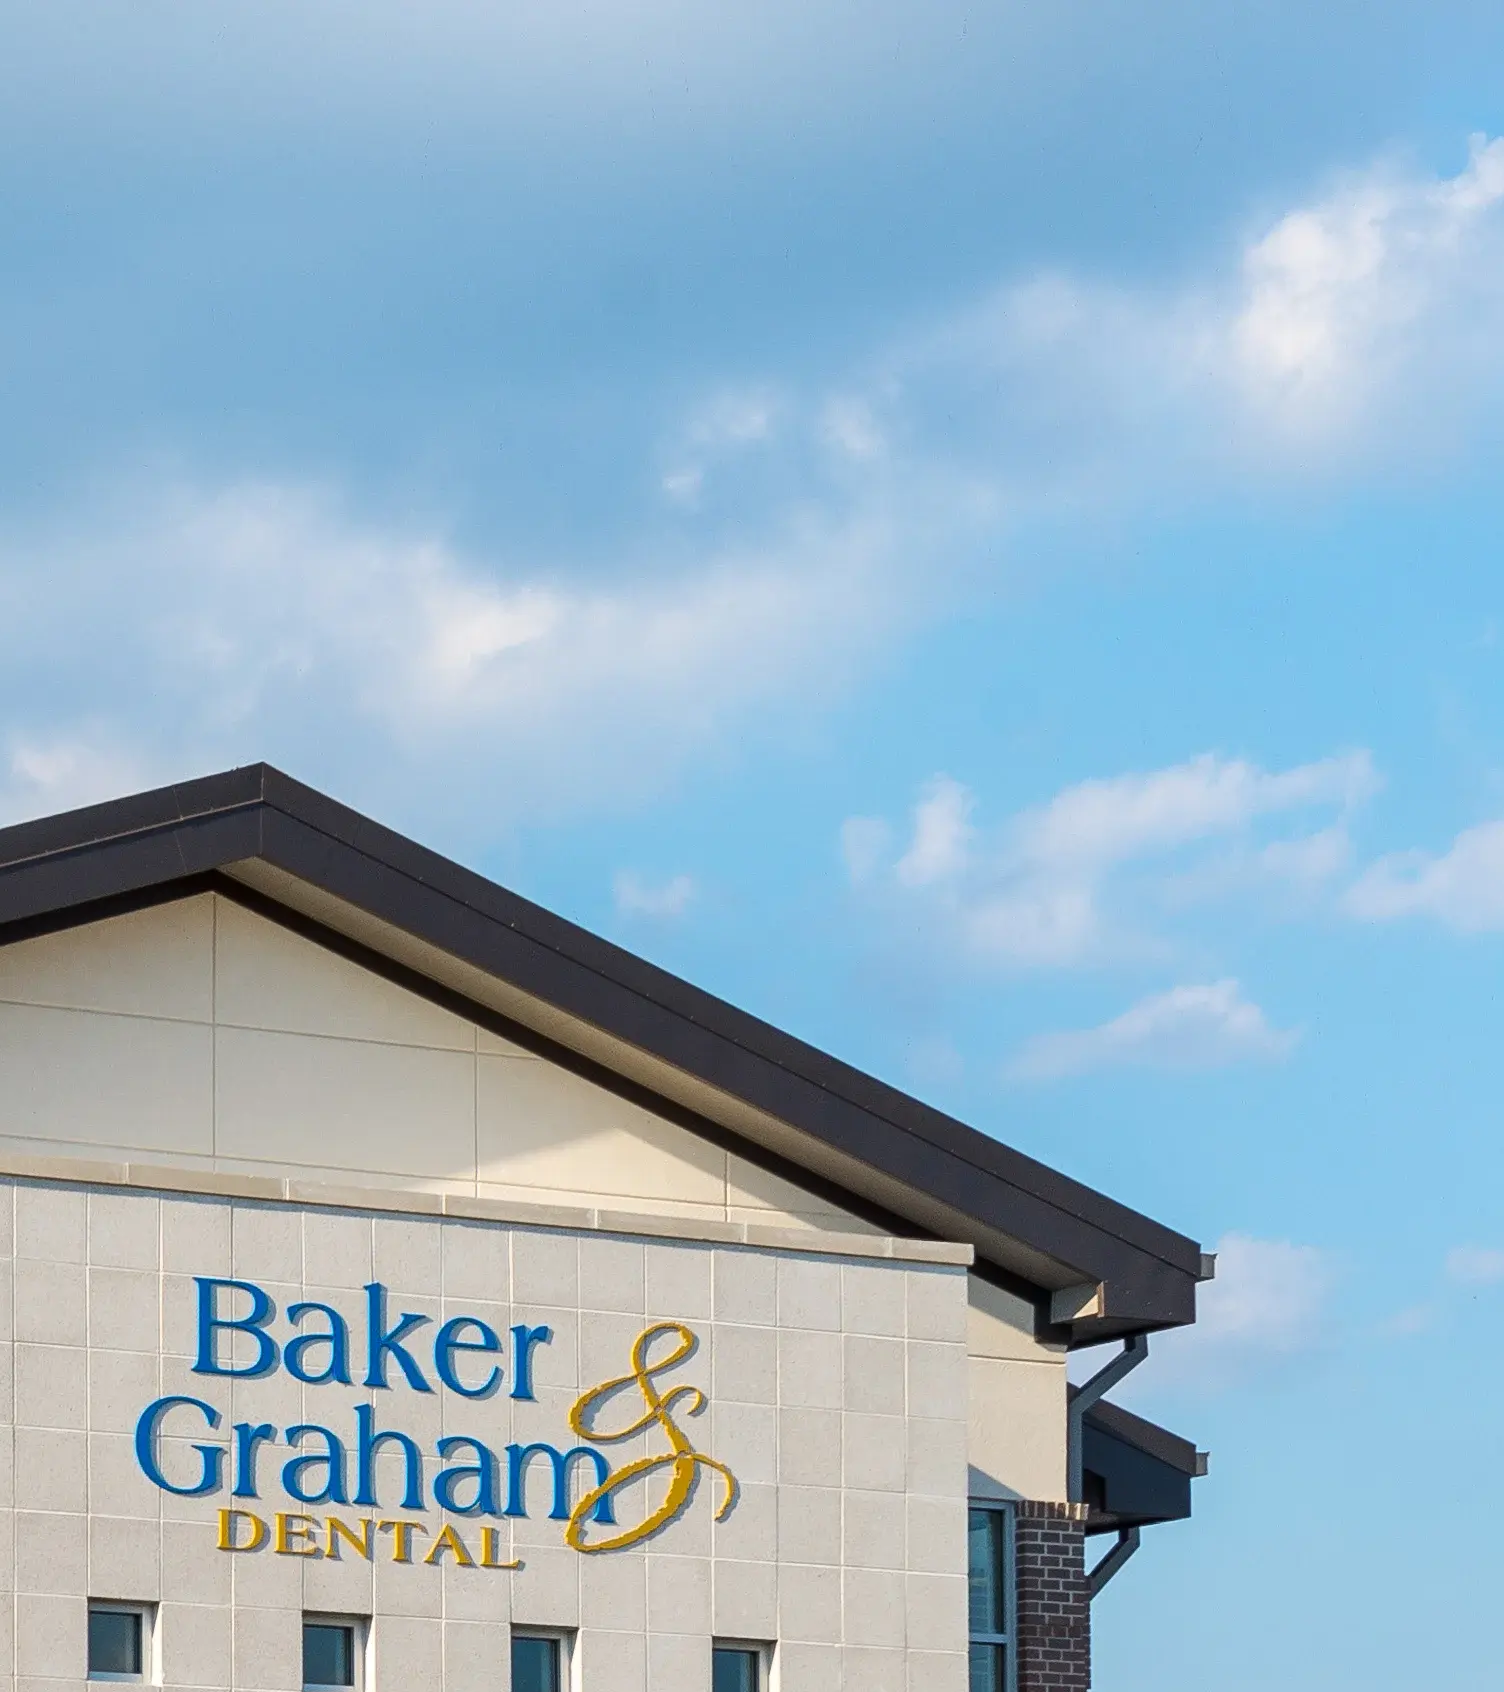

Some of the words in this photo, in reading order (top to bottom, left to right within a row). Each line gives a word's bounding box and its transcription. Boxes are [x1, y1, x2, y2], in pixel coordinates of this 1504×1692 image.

[134, 1395, 615, 1523] Graham
[191, 1276, 549, 1401] Baker
[564, 1321, 734, 1552] &
[216, 1507, 522, 1569] DENTAL
